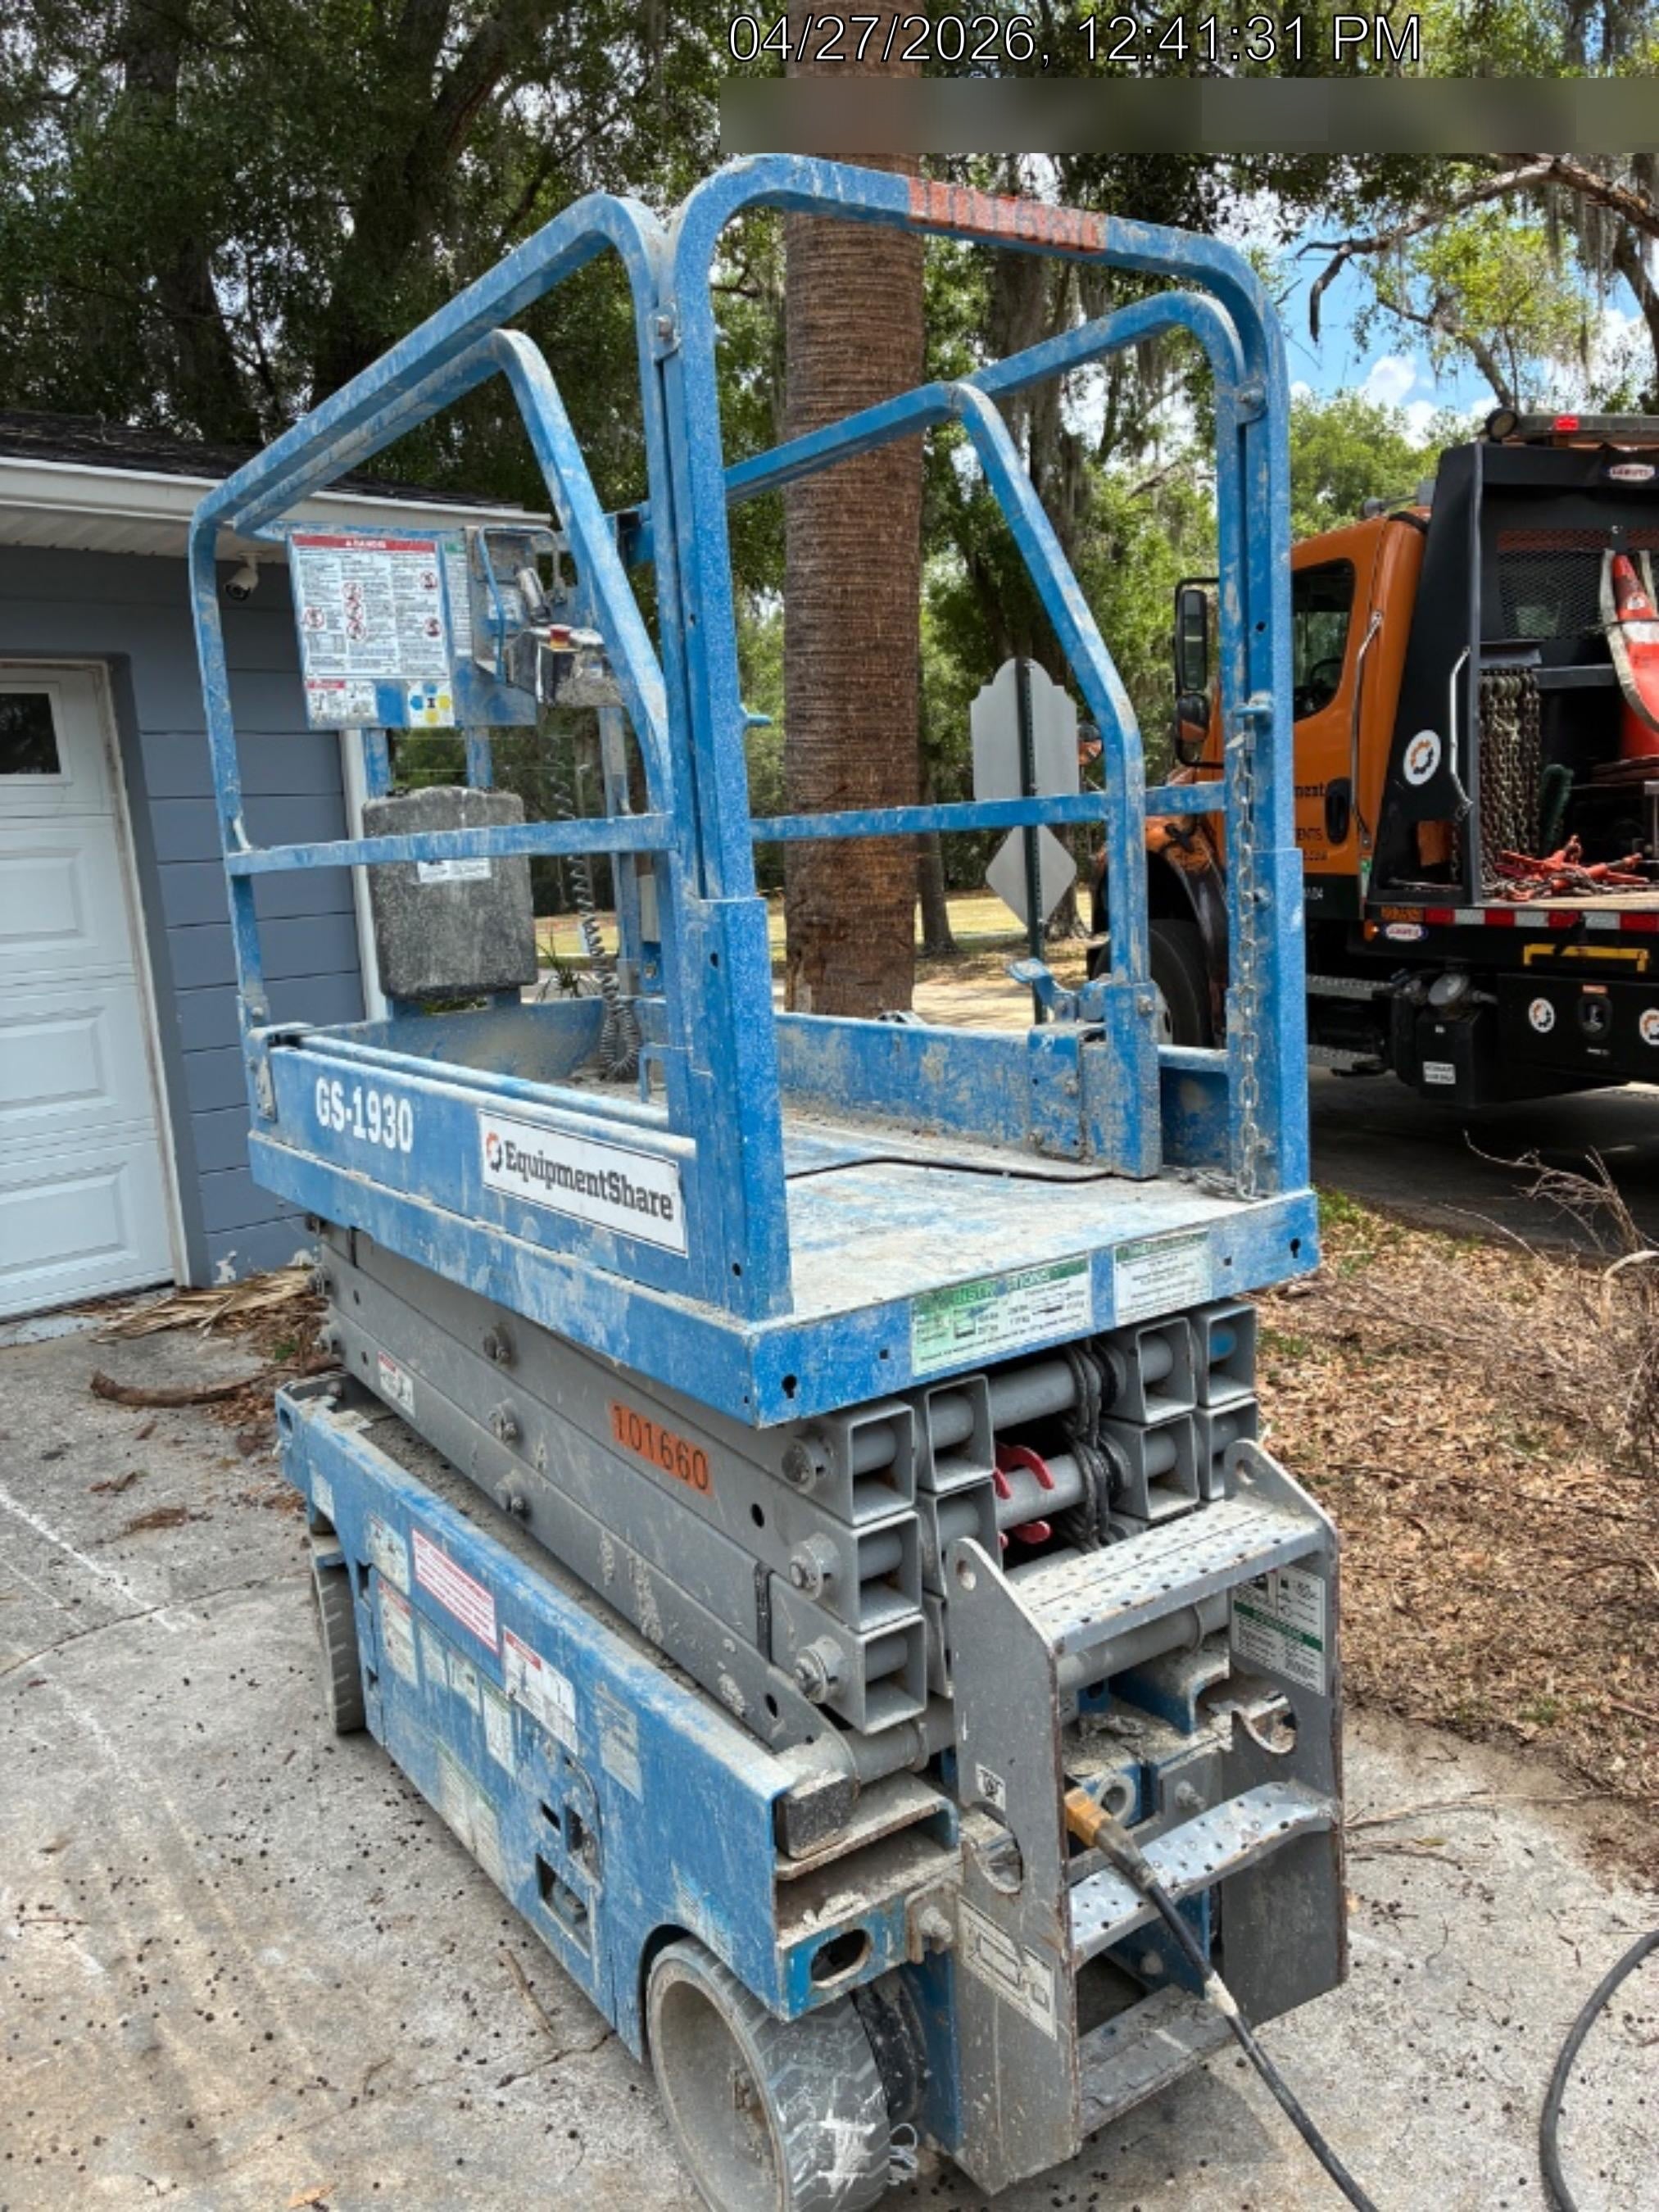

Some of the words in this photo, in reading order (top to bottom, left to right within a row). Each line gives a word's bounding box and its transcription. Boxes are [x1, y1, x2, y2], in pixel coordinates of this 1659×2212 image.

[315, 1077, 414, 1154] GS-1930
[504, 1140, 675, 1222] EquipmentShare
[613, 1404, 709, 1491] 101660
